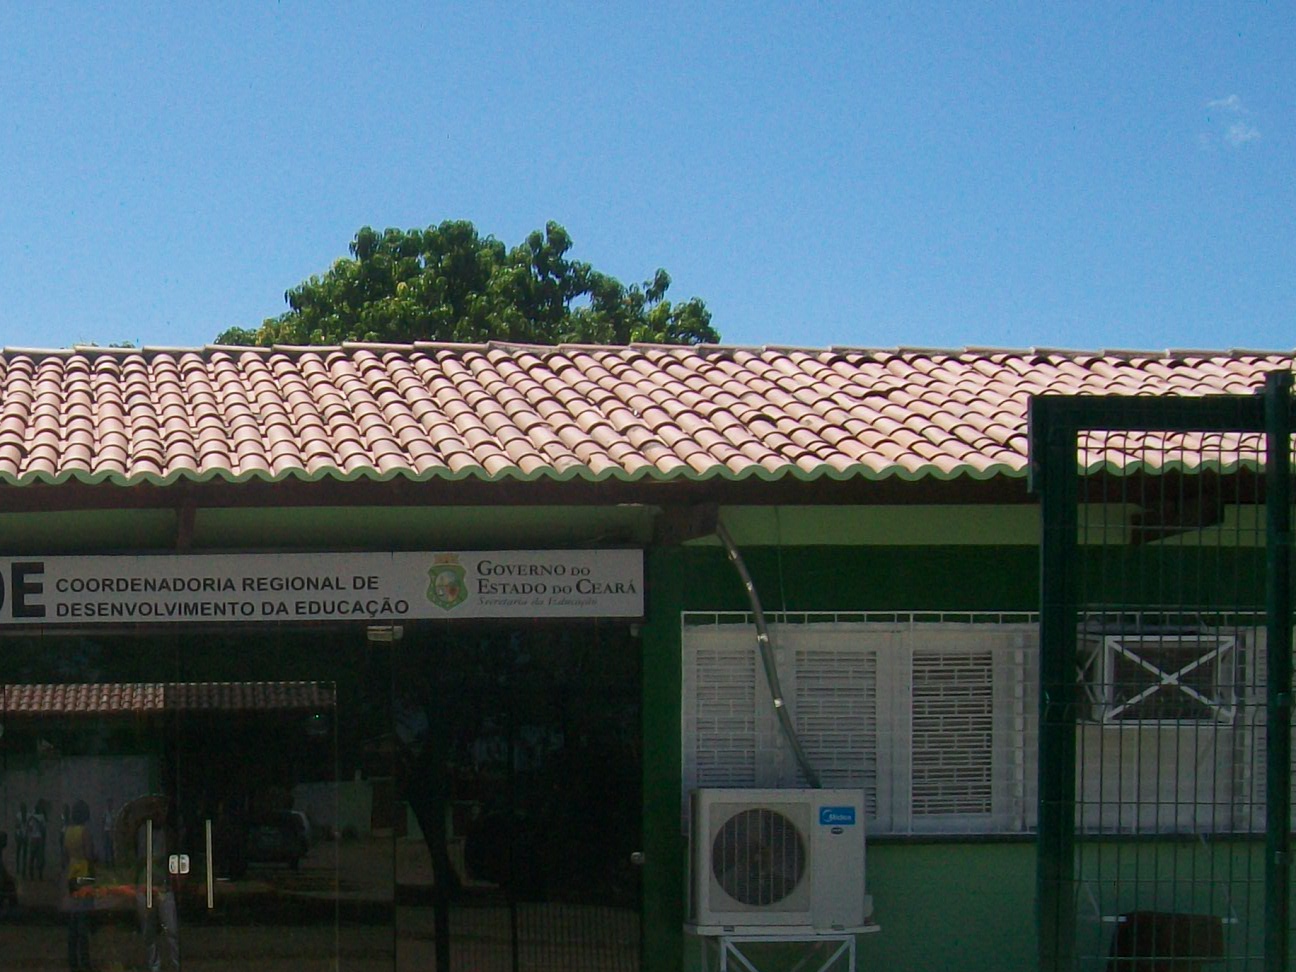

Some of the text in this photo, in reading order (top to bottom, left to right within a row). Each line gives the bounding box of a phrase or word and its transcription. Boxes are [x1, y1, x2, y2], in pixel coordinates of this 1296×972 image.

[55, 575, 380, 593] COORDENADORIA REGIONAL DE
[56, 597, 410, 619] DESENVOLVIMENTO DA EDUCAÇÃO
